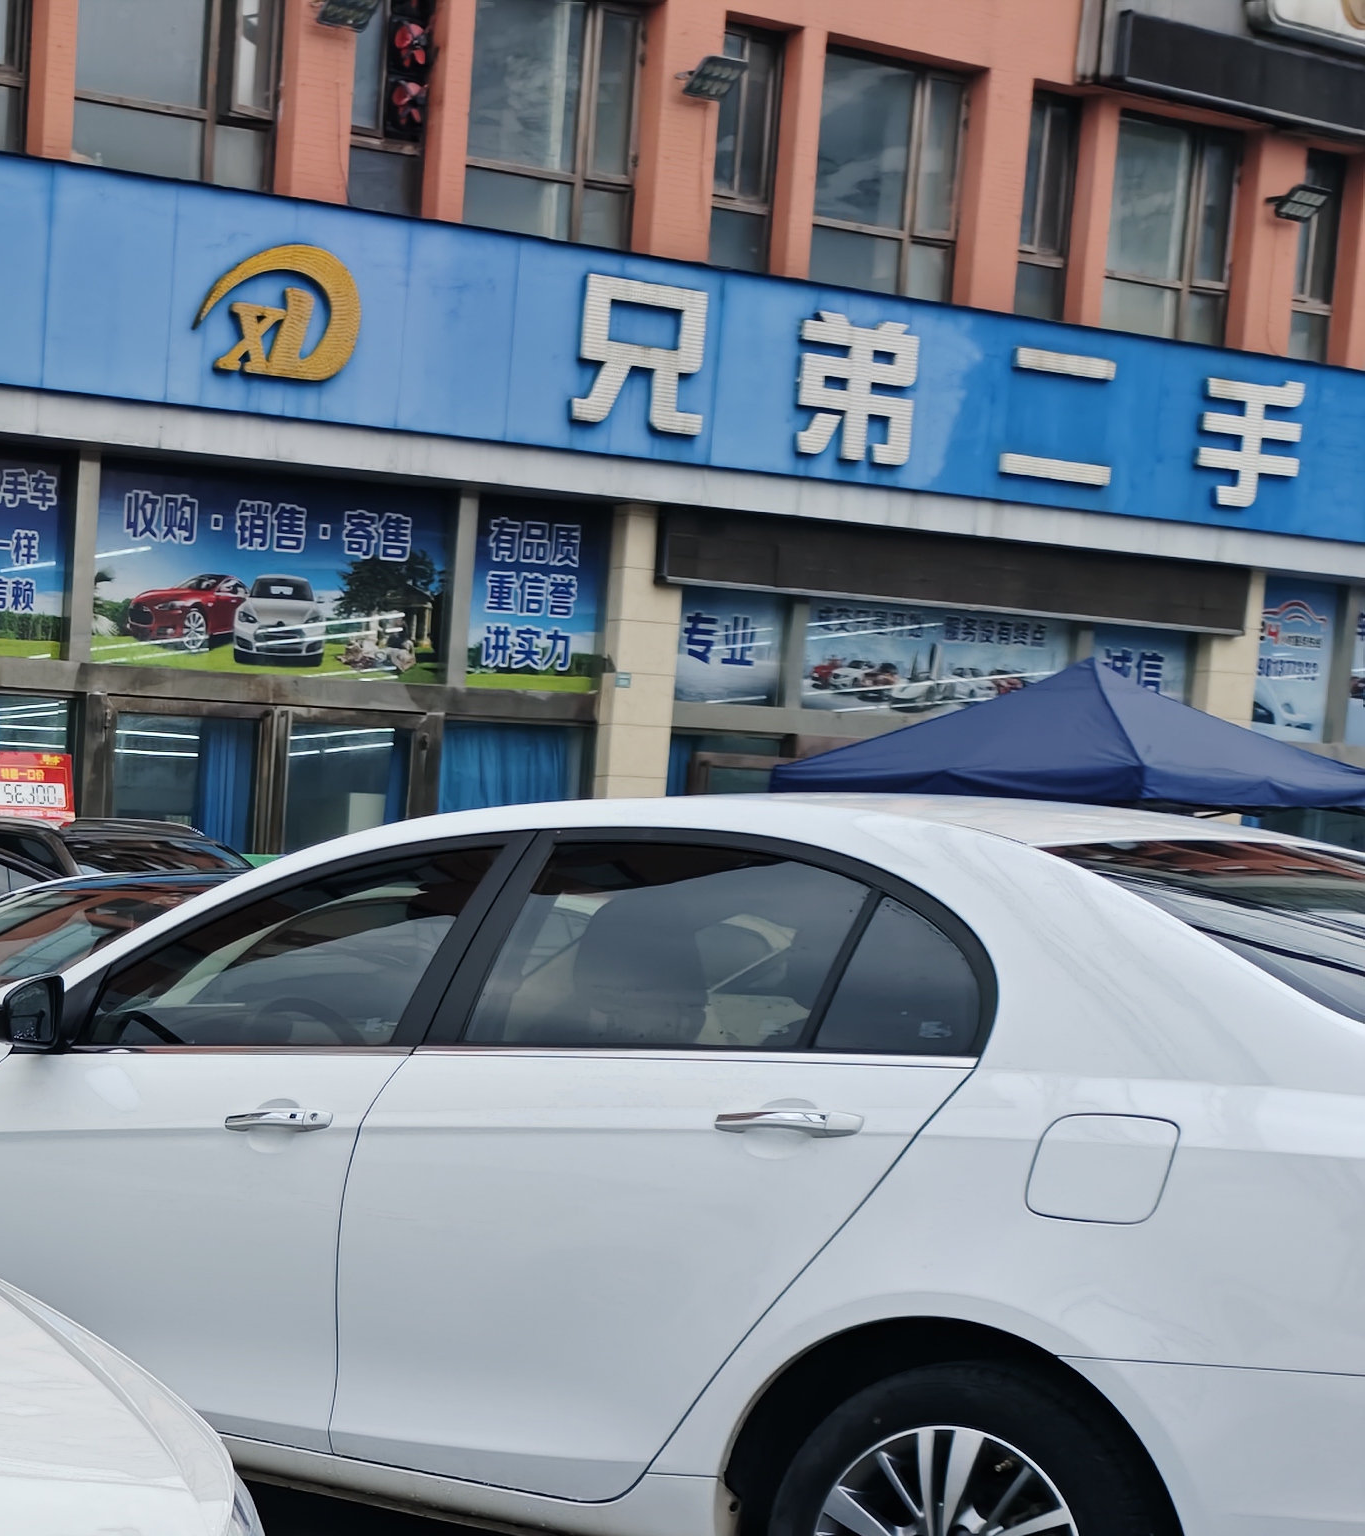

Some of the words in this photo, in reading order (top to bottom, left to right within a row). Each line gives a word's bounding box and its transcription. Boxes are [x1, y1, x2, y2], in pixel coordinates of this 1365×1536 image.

[571, 272, 1306, 509] 兄弟二手
[489, 517, 581, 568] 有品质
[484, 571, 578, 618] 重信誉
[481, 623, 572, 672] 讲实力
[684, 610, 758, 666] 专业
